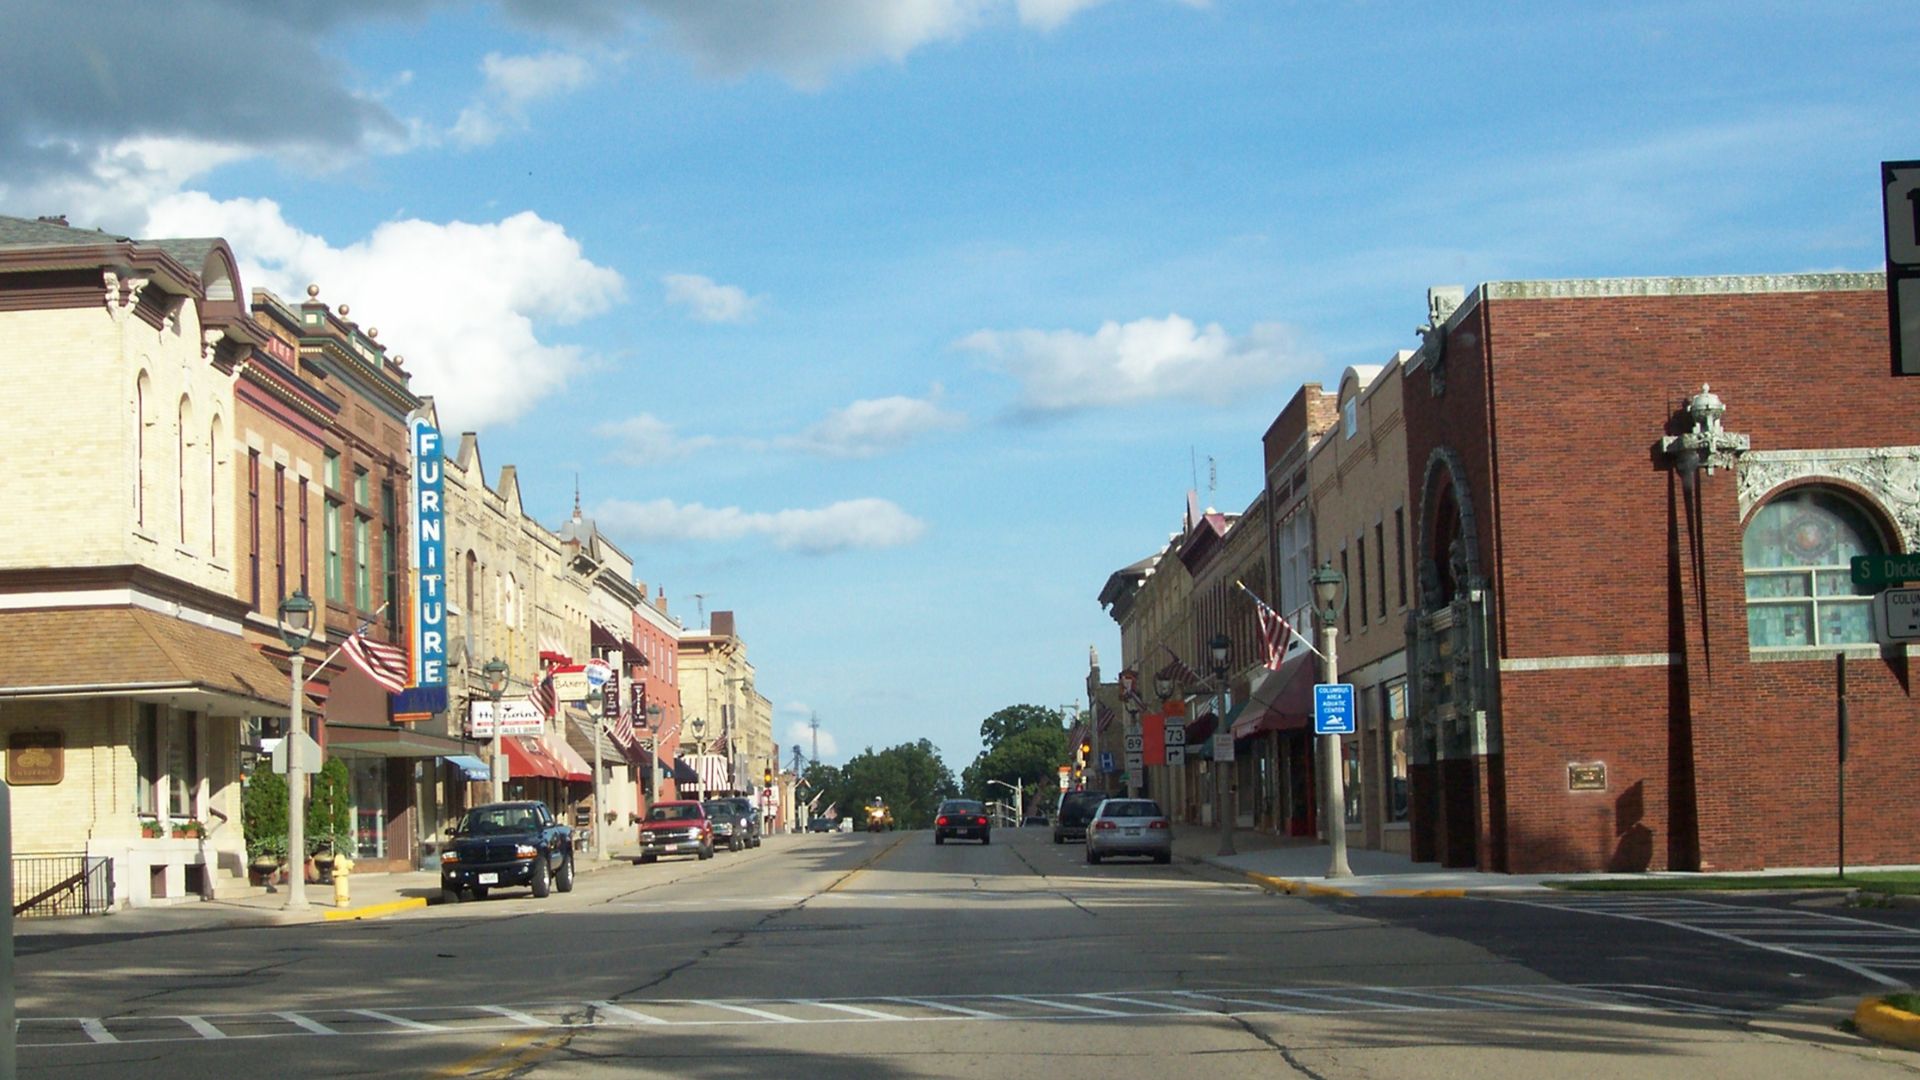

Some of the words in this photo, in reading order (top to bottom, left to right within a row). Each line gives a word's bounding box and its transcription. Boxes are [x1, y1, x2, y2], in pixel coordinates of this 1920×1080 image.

[420, 432, 442, 684] FURNITURE
[1861, 560, 1871, 579] S
[1128, 738, 1142, 749] 89
[1167, 730, 1184, 742] 73
